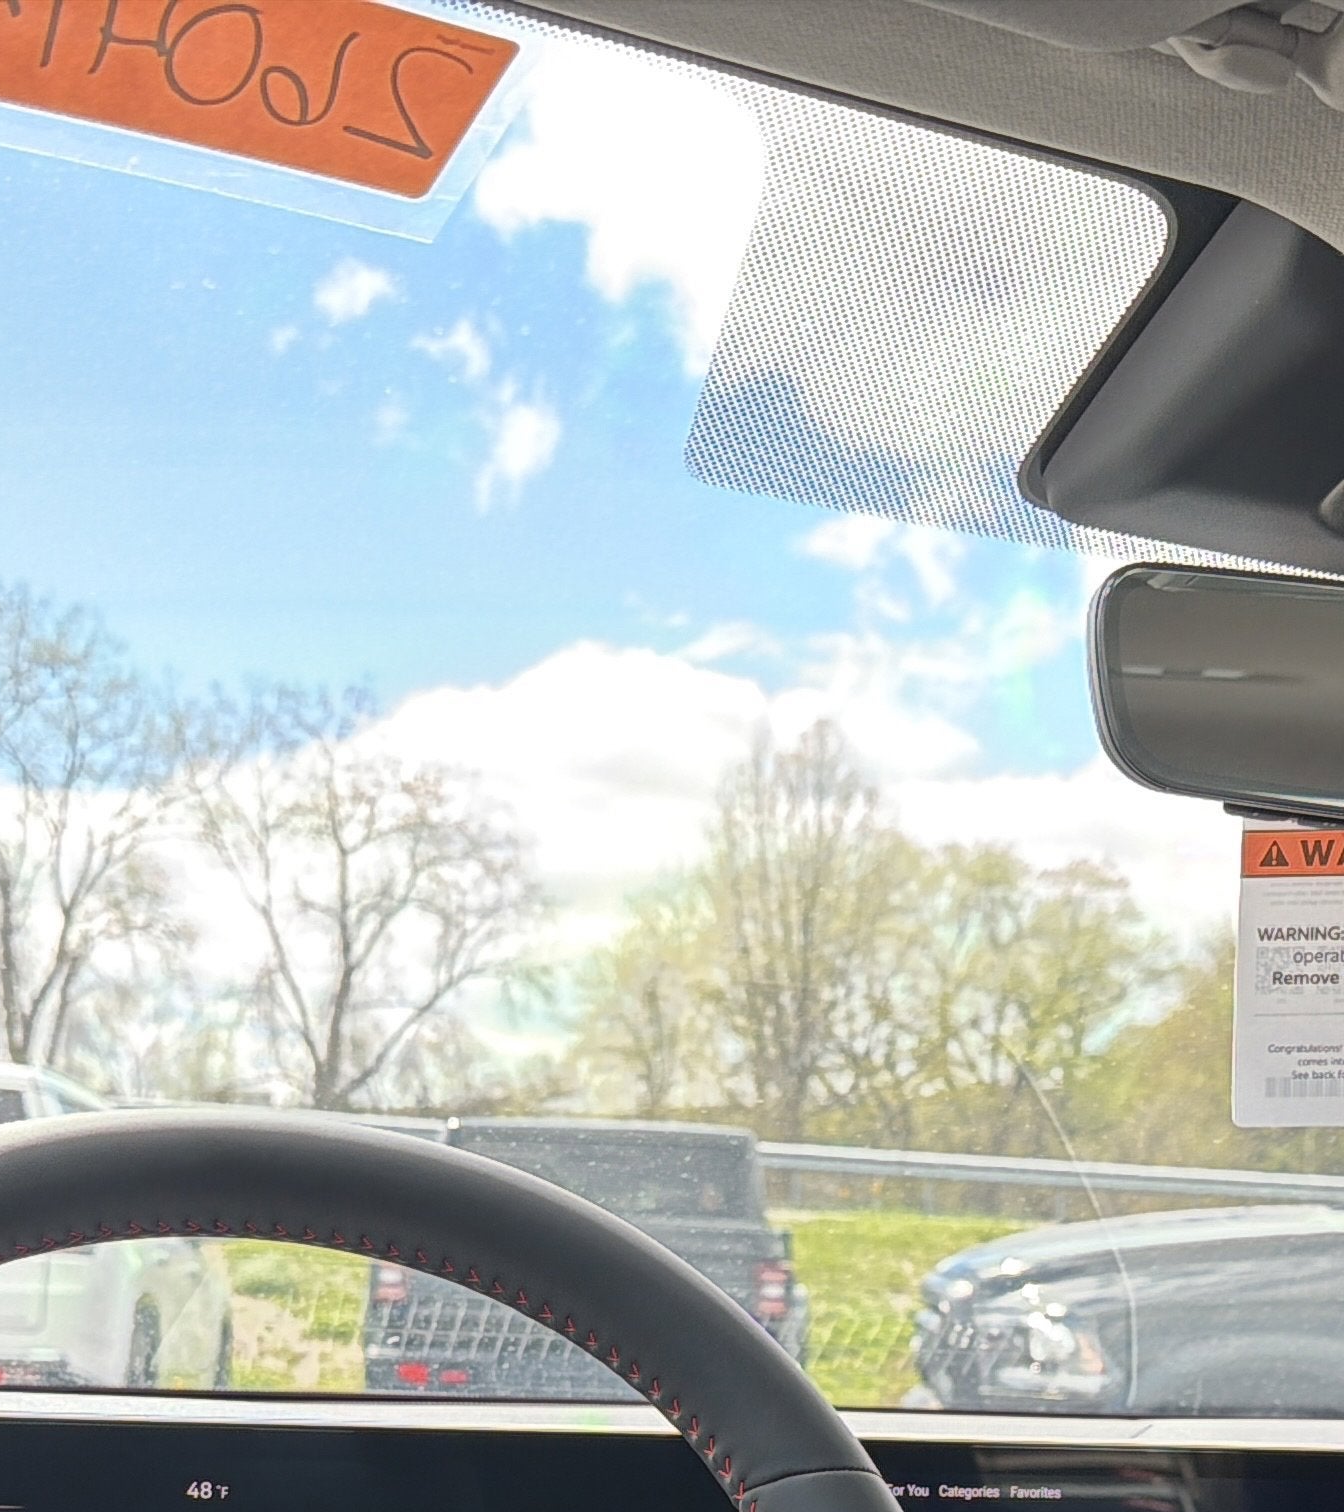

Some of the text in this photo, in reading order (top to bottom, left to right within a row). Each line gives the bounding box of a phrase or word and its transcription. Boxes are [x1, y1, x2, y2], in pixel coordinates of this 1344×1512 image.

[1272, 971, 1340, 985] Remove
[1291, 1070, 1307, 1080] See
[1312, 1070, 1335, 1080] back
[907, 1484, 930, 1497] You
[938, 1484, 1000, 1500] Categories
[1010, 1485, 1062, 1499] Favorites
